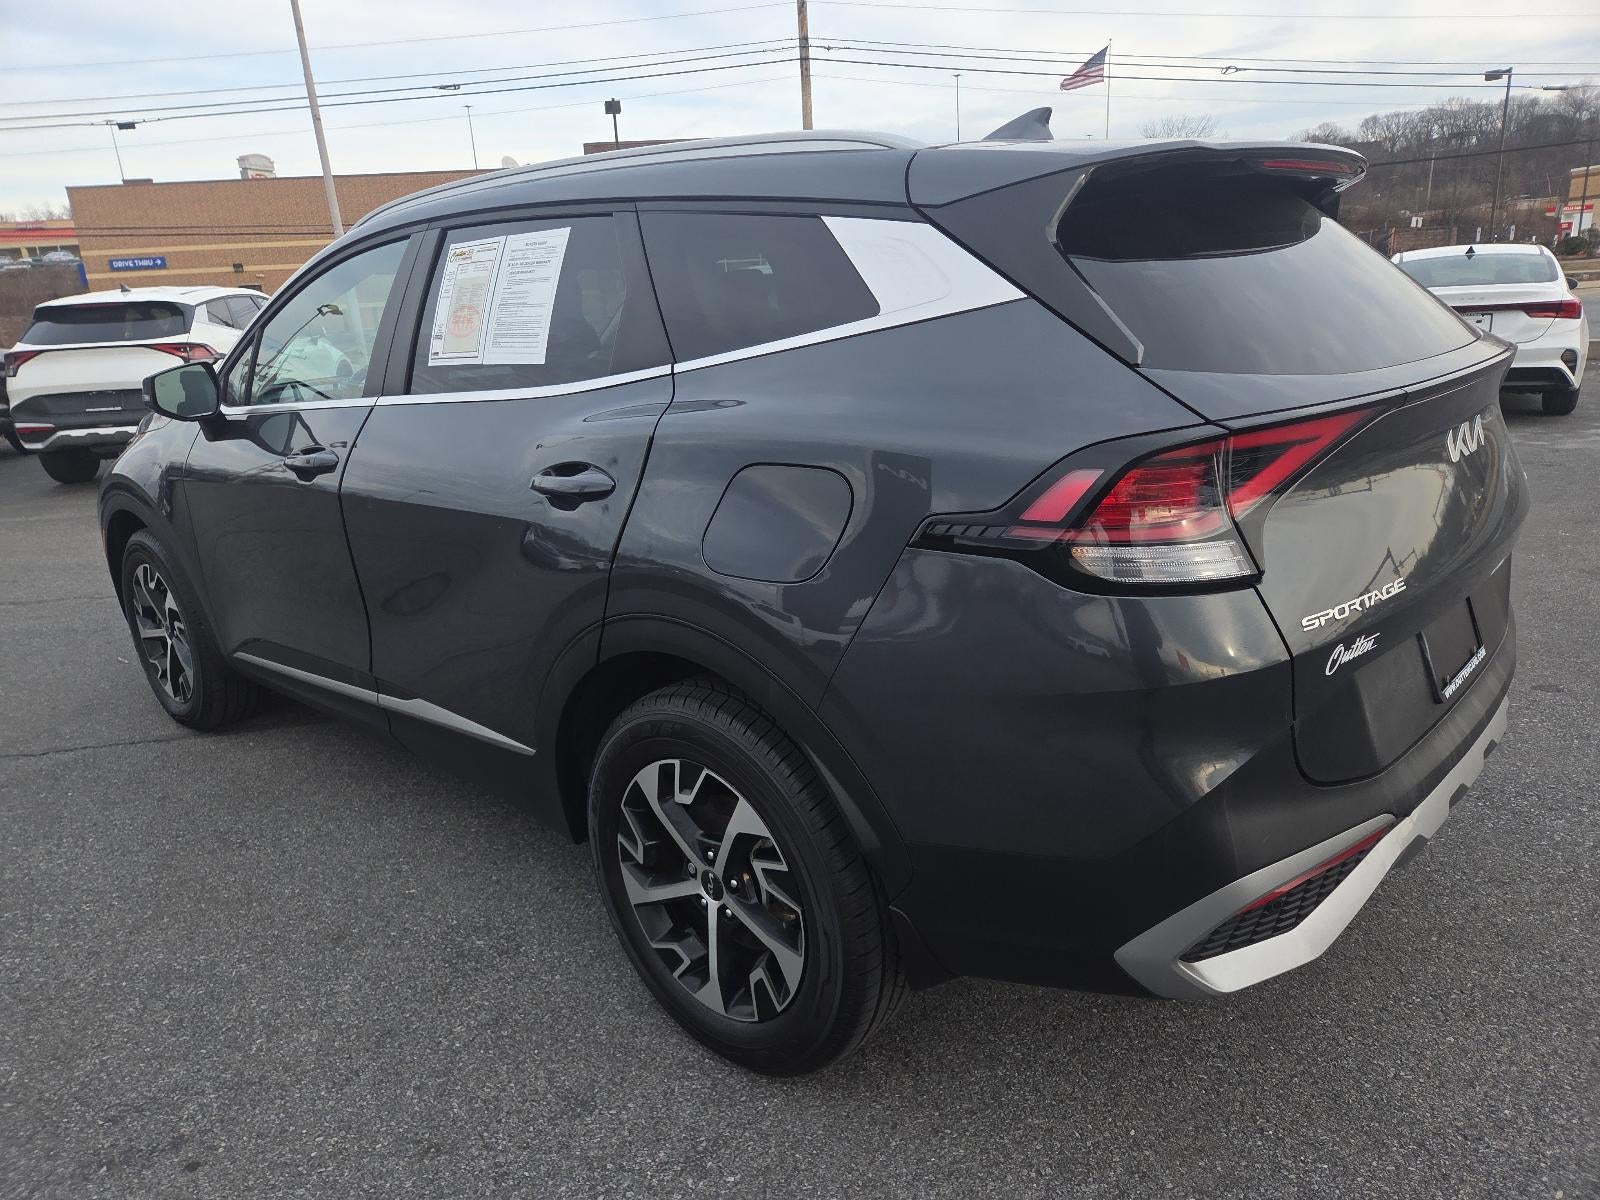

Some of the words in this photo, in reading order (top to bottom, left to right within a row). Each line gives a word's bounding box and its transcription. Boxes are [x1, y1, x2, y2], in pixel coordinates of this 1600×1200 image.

[112, 260, 133, 268] DRIVE
[134, 259, 153, 267] THRU
[1447, 414, 1485, 463] KIA
[1301, 577, 1407, 632] SPORTAGE
[1325, 632, 1380, 676] Outten
